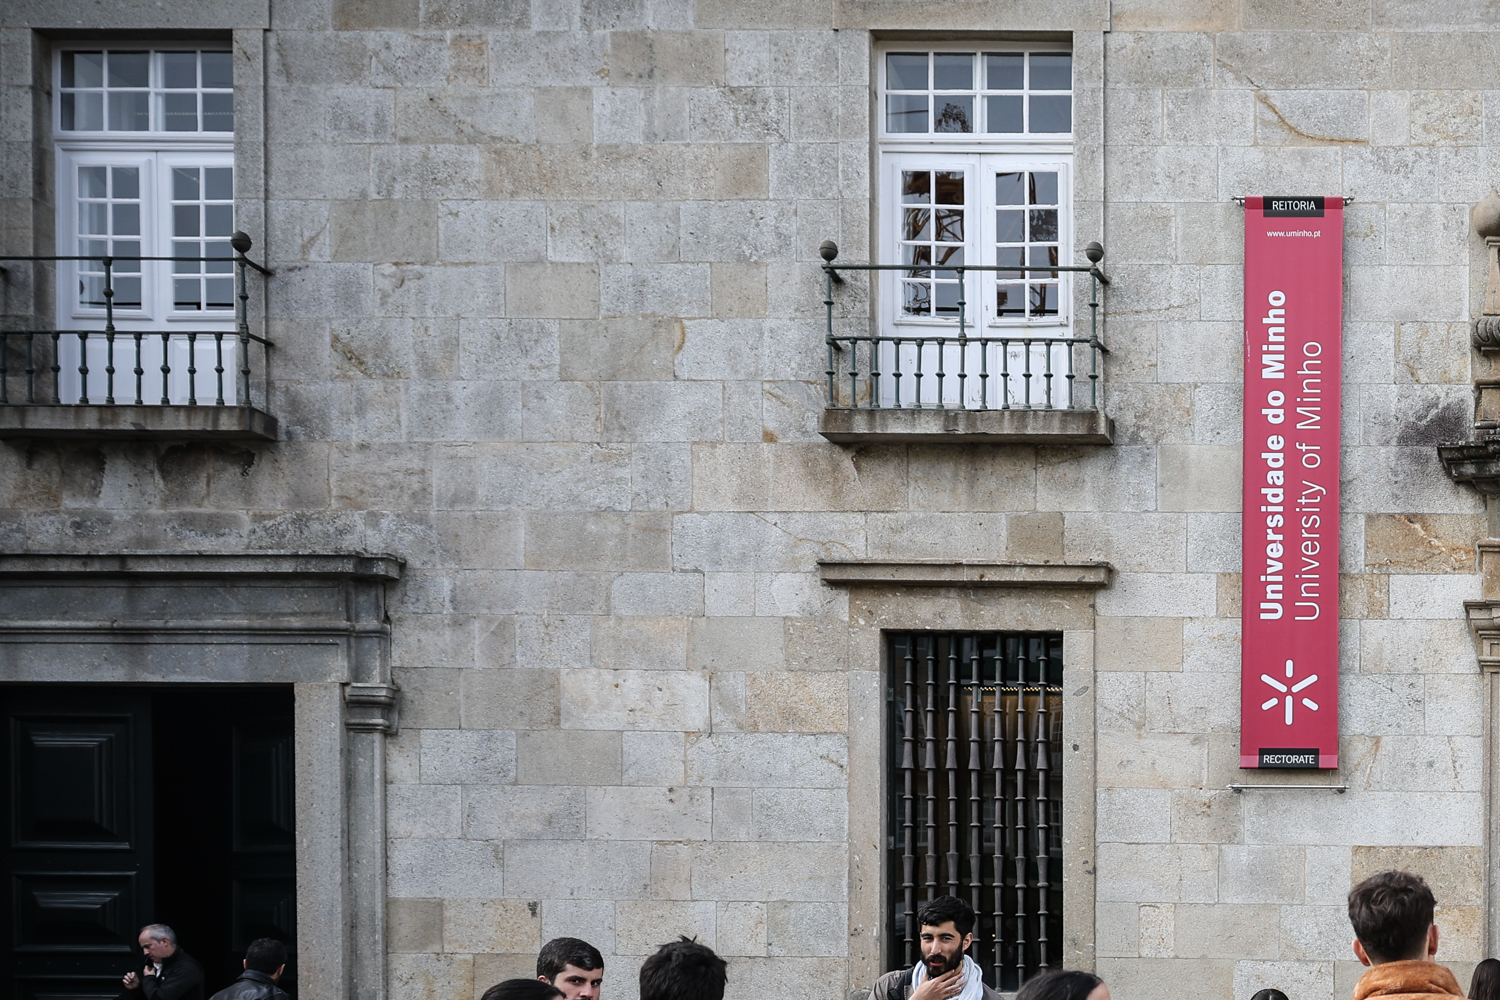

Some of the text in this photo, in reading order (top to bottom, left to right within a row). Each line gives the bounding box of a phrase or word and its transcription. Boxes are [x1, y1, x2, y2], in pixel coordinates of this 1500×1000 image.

[1272, 200, 1316, 211] REITORIA
[1266, 229, 1321, 239] www.uminho.pt
[1260, 290, 1286, 620] Universidade do Minho
[1294, 341, 1327, 621] University of Minho
[1263, 754, 1316, 765] RECTORATE
